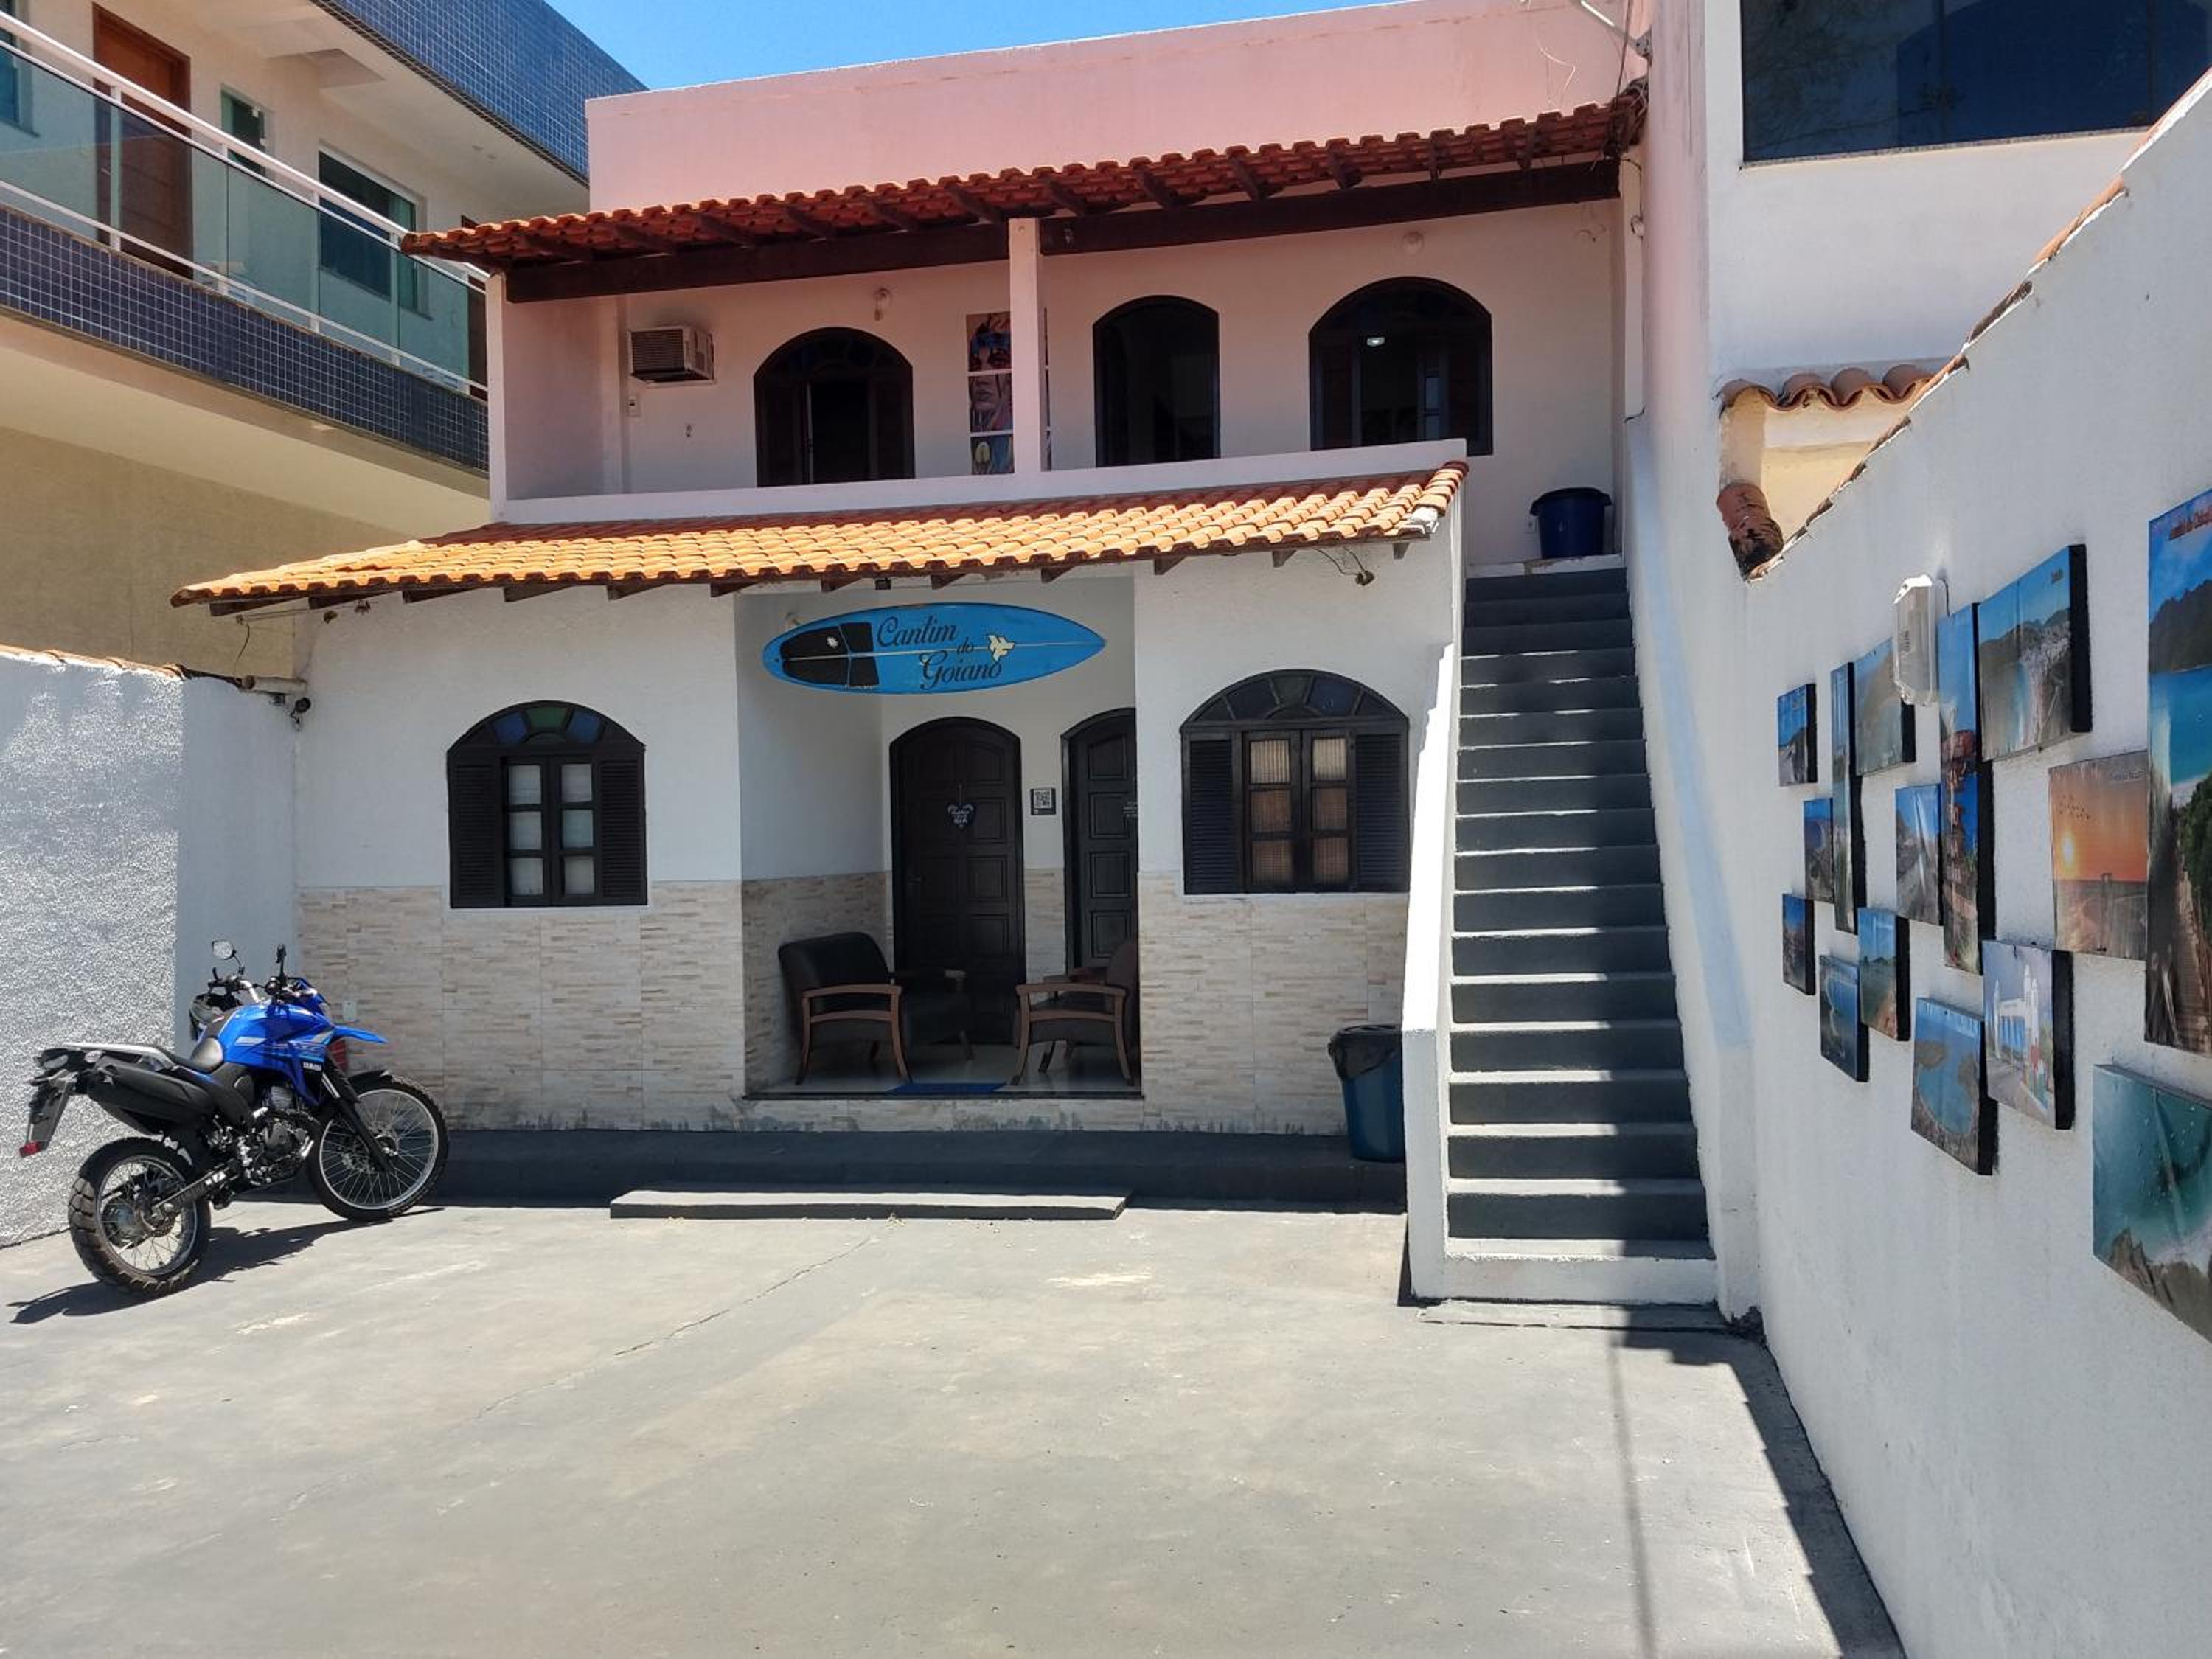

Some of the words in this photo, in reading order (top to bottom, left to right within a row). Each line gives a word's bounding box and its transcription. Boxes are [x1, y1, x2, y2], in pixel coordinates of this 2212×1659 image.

[877, 616, 956, 647] Cantim
[957, 636, 974, 655] do
[919, 650, 1002, 691] Goiano
